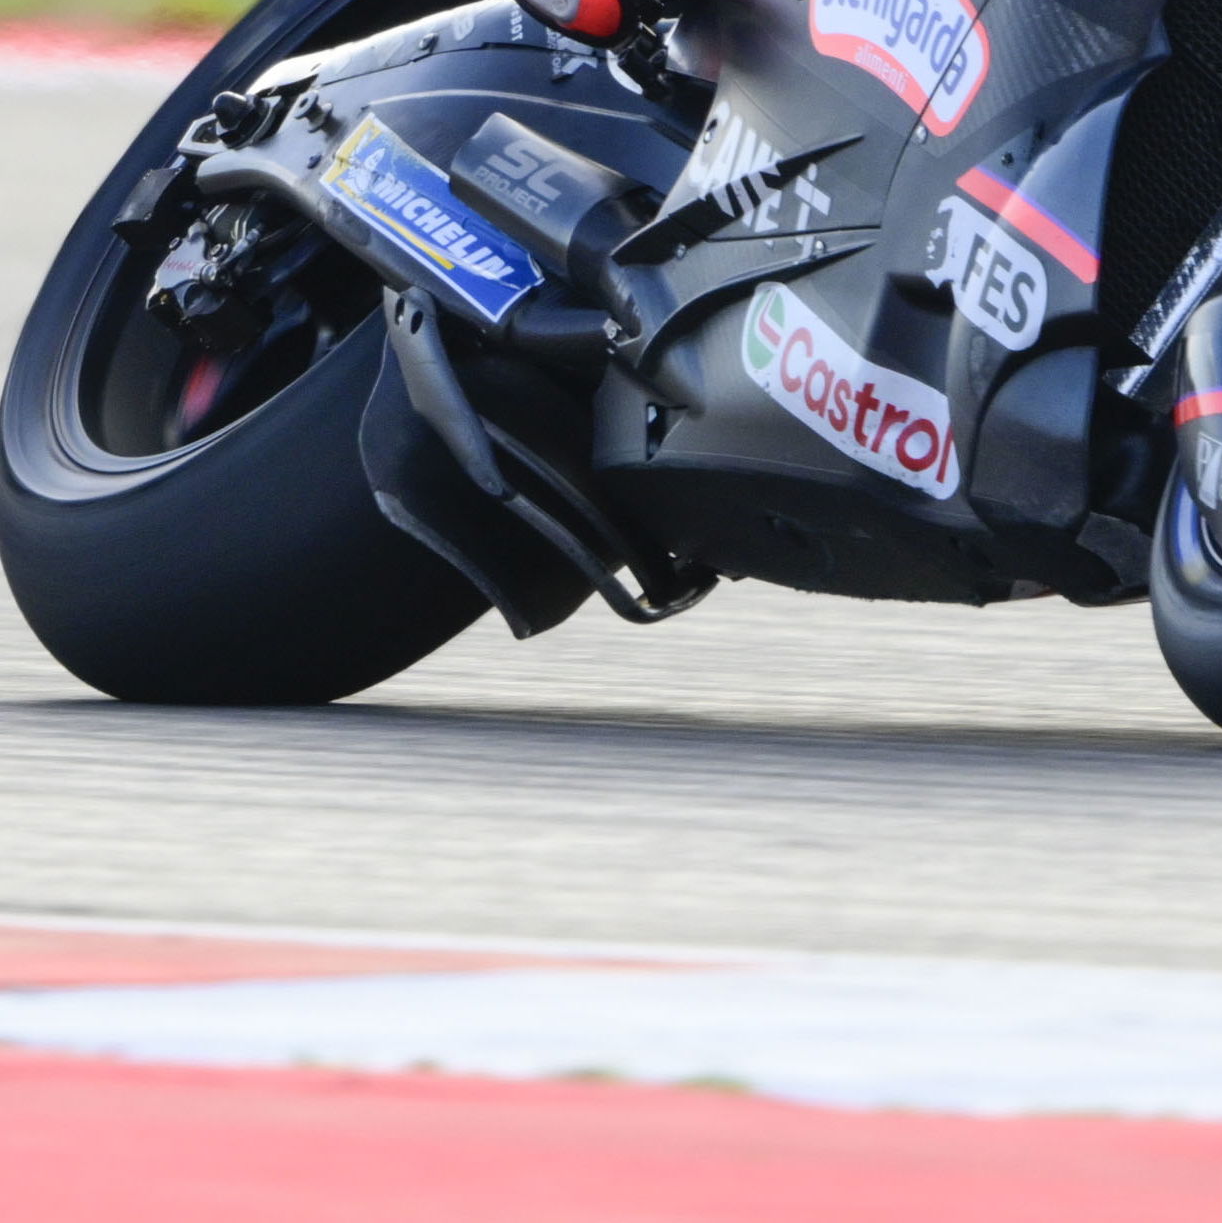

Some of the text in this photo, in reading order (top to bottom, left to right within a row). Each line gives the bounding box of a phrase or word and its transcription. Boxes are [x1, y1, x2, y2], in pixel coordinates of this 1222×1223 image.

[474, 165, 550, 215] PROJECT
[485, 138, 583, 202] SC
[372, 172, 515, 280] MICHELIN
[780, 327, 953, 484] Castrol
